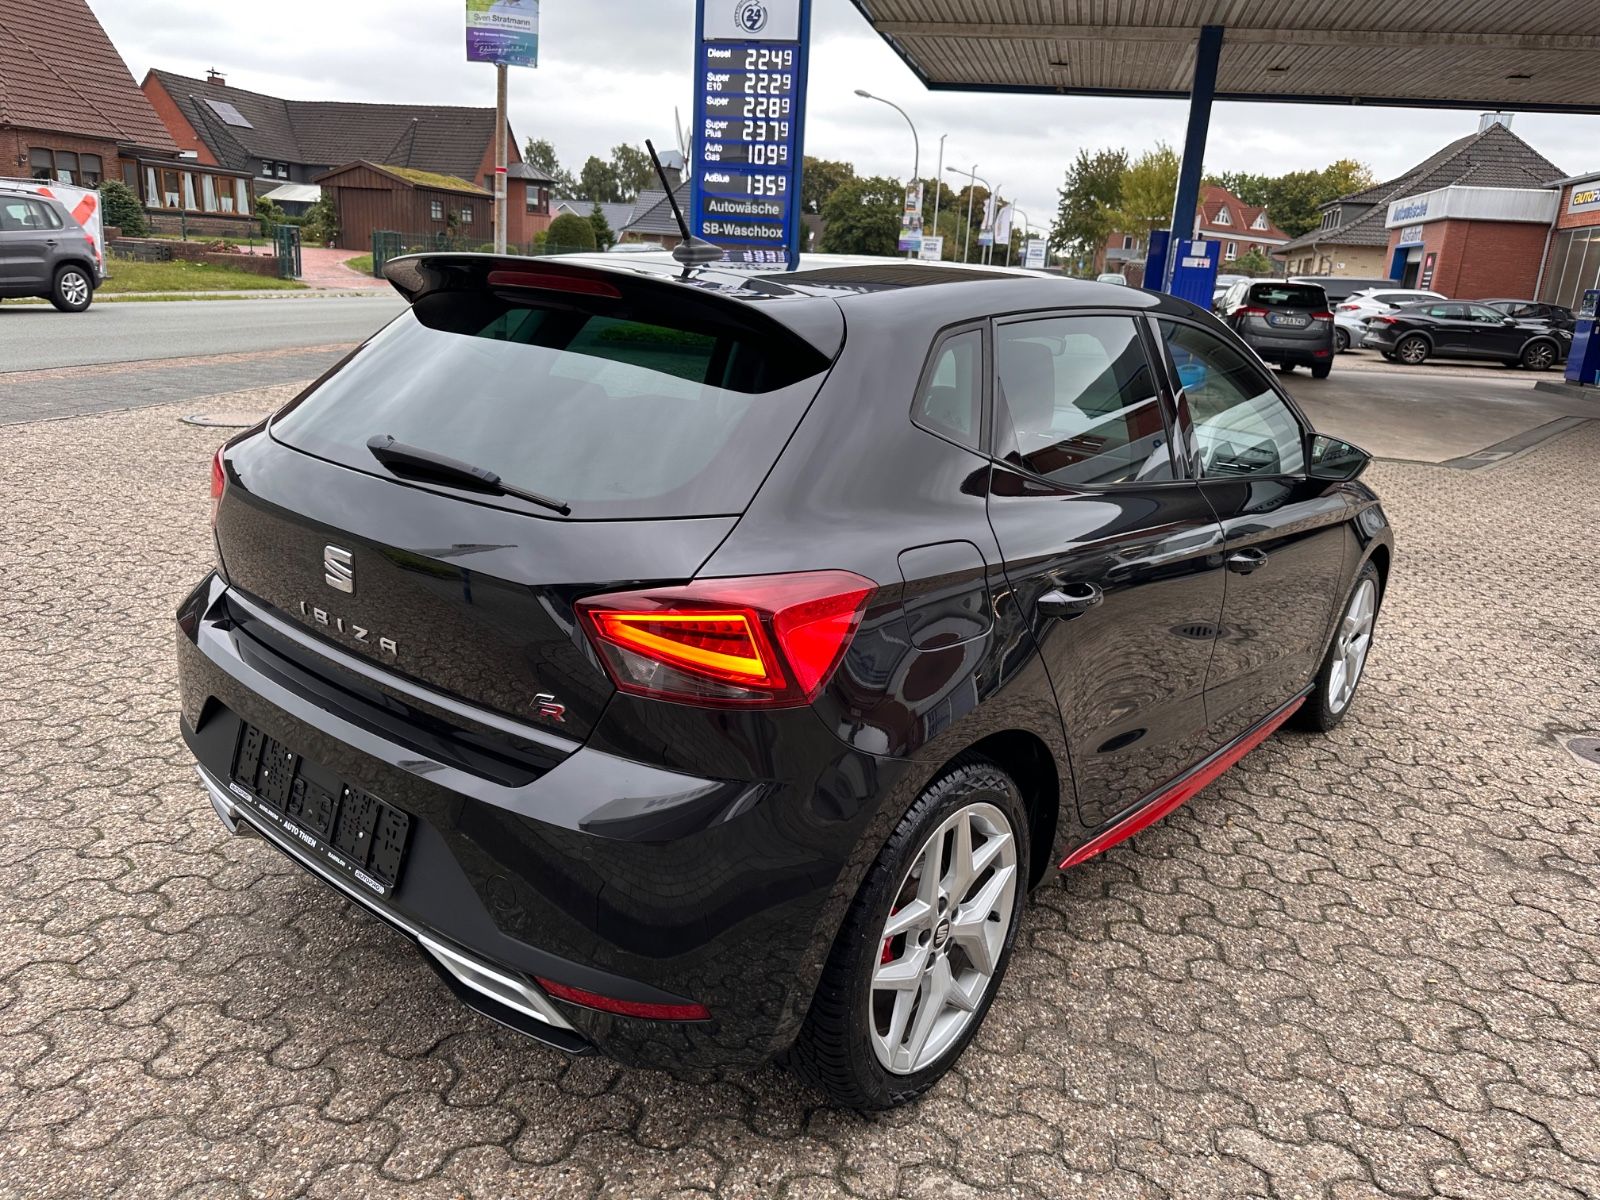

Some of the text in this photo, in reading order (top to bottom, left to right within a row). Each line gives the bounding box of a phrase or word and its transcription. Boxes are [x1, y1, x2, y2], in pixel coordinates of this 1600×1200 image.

[473, 13, 531, 26] Sven Stratmann
[746, 8, 762, 21] 24
[707, 48, 792, 70] Diesel 2249
[706, 71, 730, 82] Super
[744, 72, 791, 94] 2229
[706, 82, 722, 91] E10
[706, 95, 790, 118] Super 2289
[705, 118, 728, 129] Super
[742, 119, 788, 141] 2379
[705, 129, 721, 138] Plus
[704, 142, 723, 152] Auto
[748, 144, 788, 165] 1099
[704, 152, 720, 161] Gas
[704, 172, 786, 196] AdBlue 1359
[708, 200, 780, 215] Autowäsche
[702, 221, 783, 238] SB-Waschbox
[301, 601, 398, 655] IBIZA
[530, 693, 566, 722] FR
[283, 821, 300, 837] AUTO
[299, 829, 317, 848] THIEN
